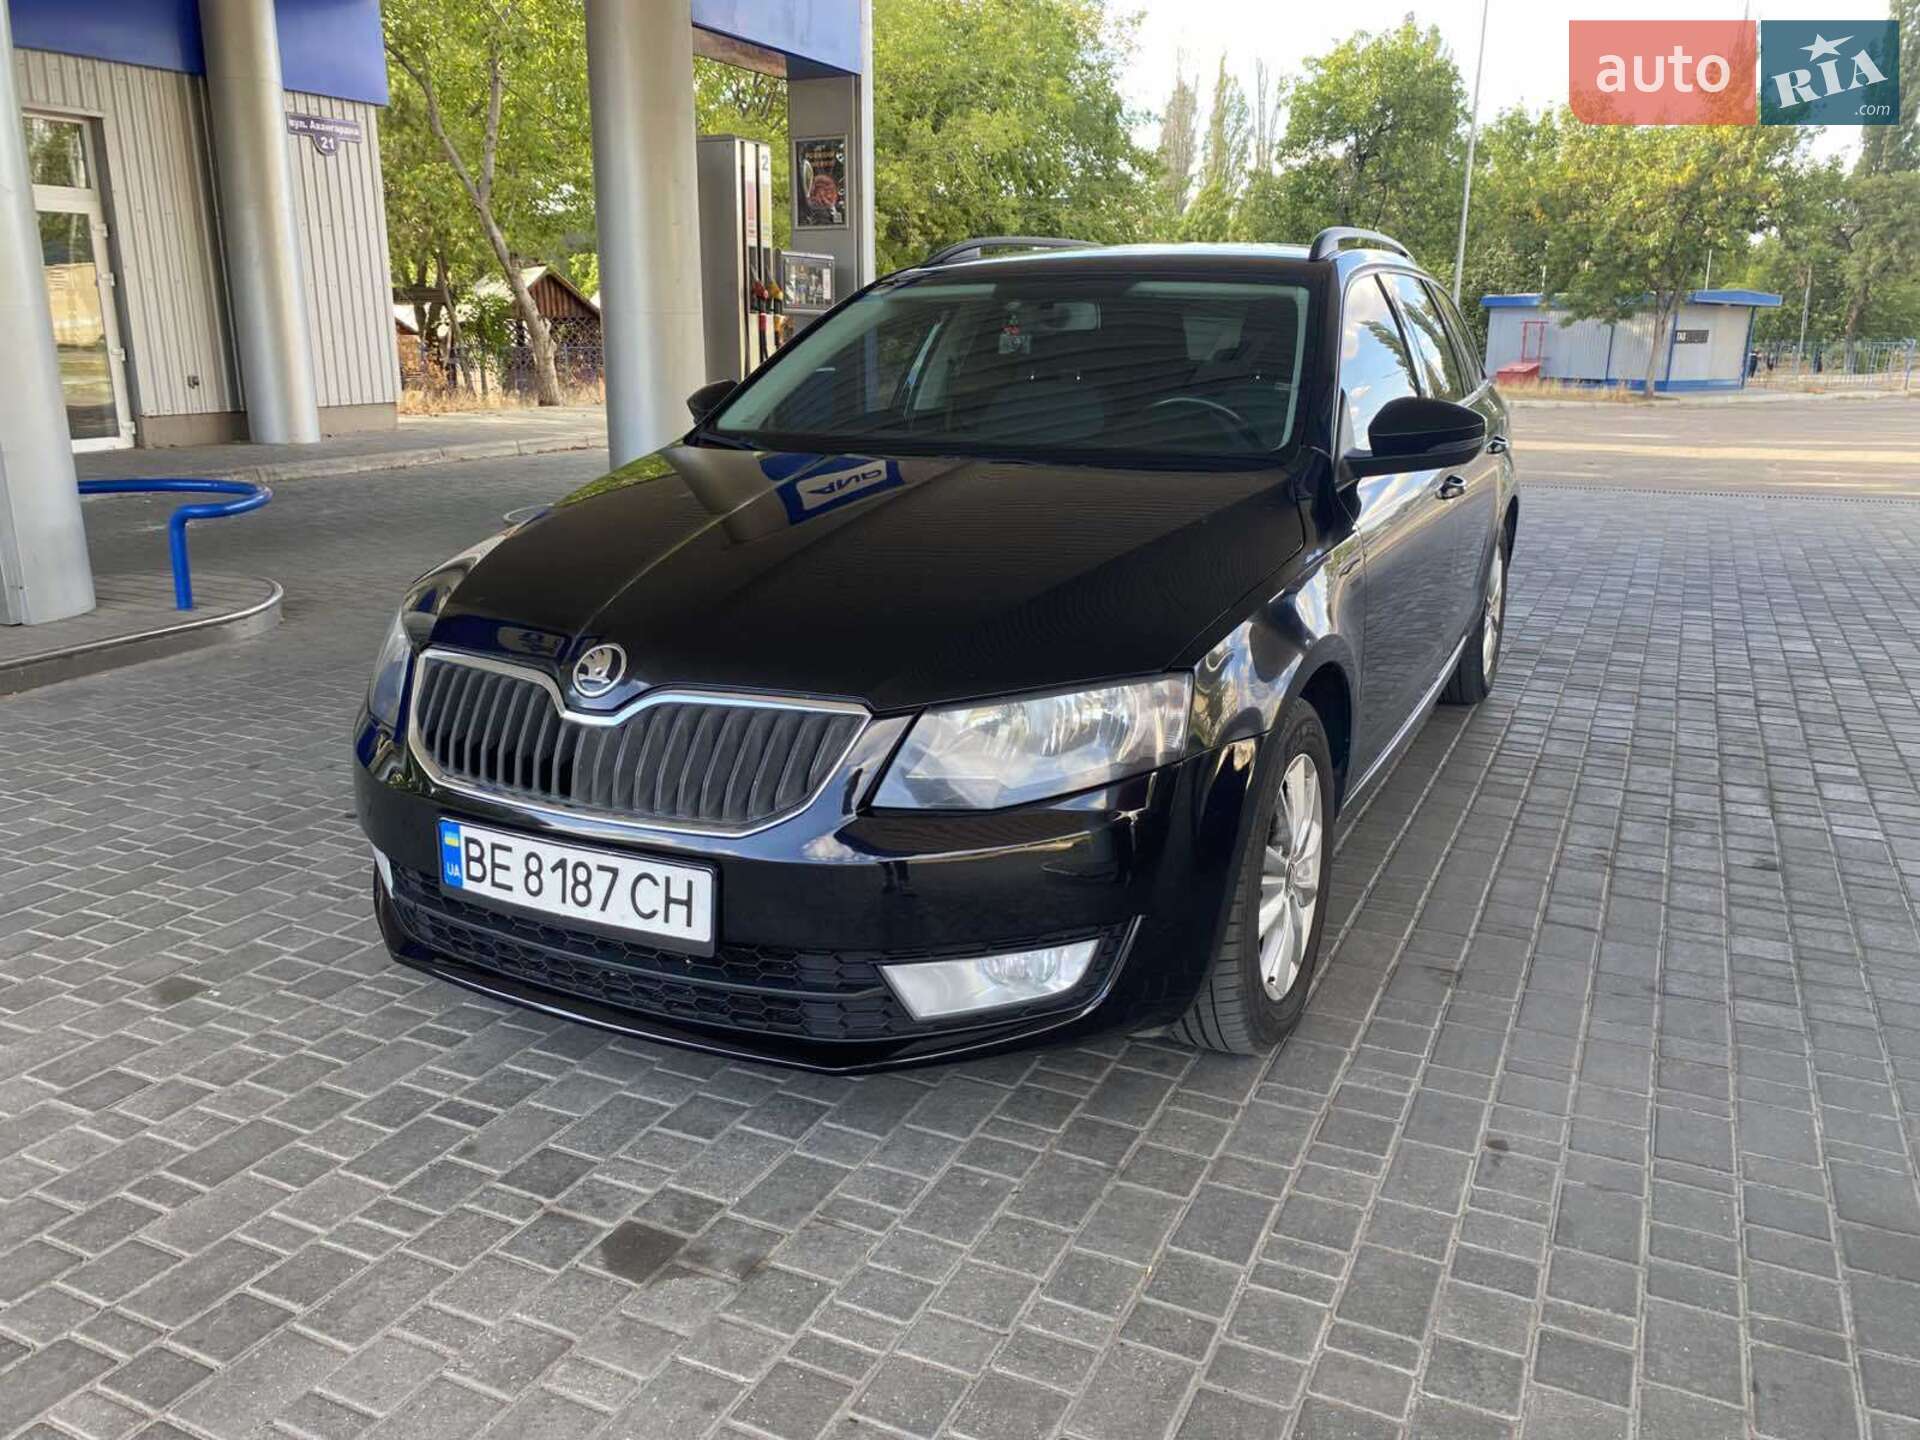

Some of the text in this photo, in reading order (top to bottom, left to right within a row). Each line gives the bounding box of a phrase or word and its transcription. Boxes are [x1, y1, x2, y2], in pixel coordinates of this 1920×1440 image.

[320, 136, 335, 150] 21
[761, 154, 769, 171] 2
[447, 862, 462, 878] UA
[464, 836, 693, 927] BE 8187 CH
